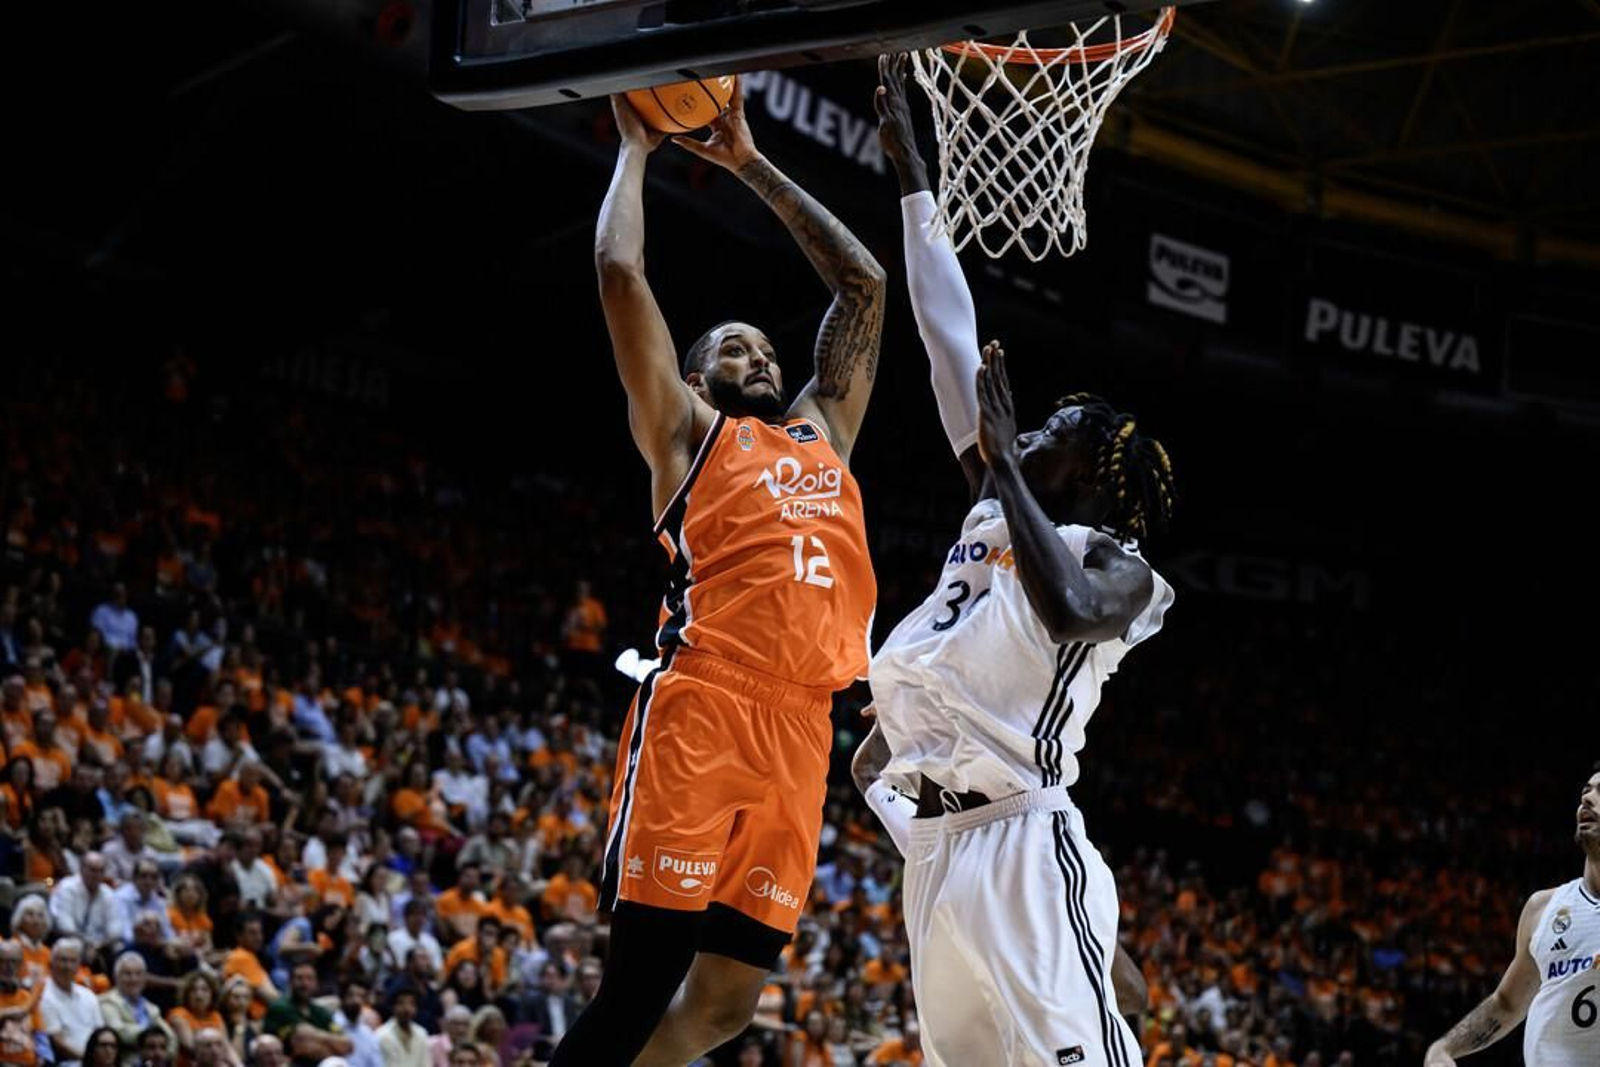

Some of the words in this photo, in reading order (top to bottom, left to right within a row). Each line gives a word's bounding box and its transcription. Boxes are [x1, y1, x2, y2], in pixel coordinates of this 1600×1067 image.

[1305, 297, 1480, 373] PULEVA
[753, 456, 842, 504] Roig
[779, 501, 844, 522] ARENA
[791, 535, 834, 589] 12
[659, 855, 716, 876] PULEVA
[754, 880, 799, 909] Midea
[1571, 985, 1597, 1028] 6
